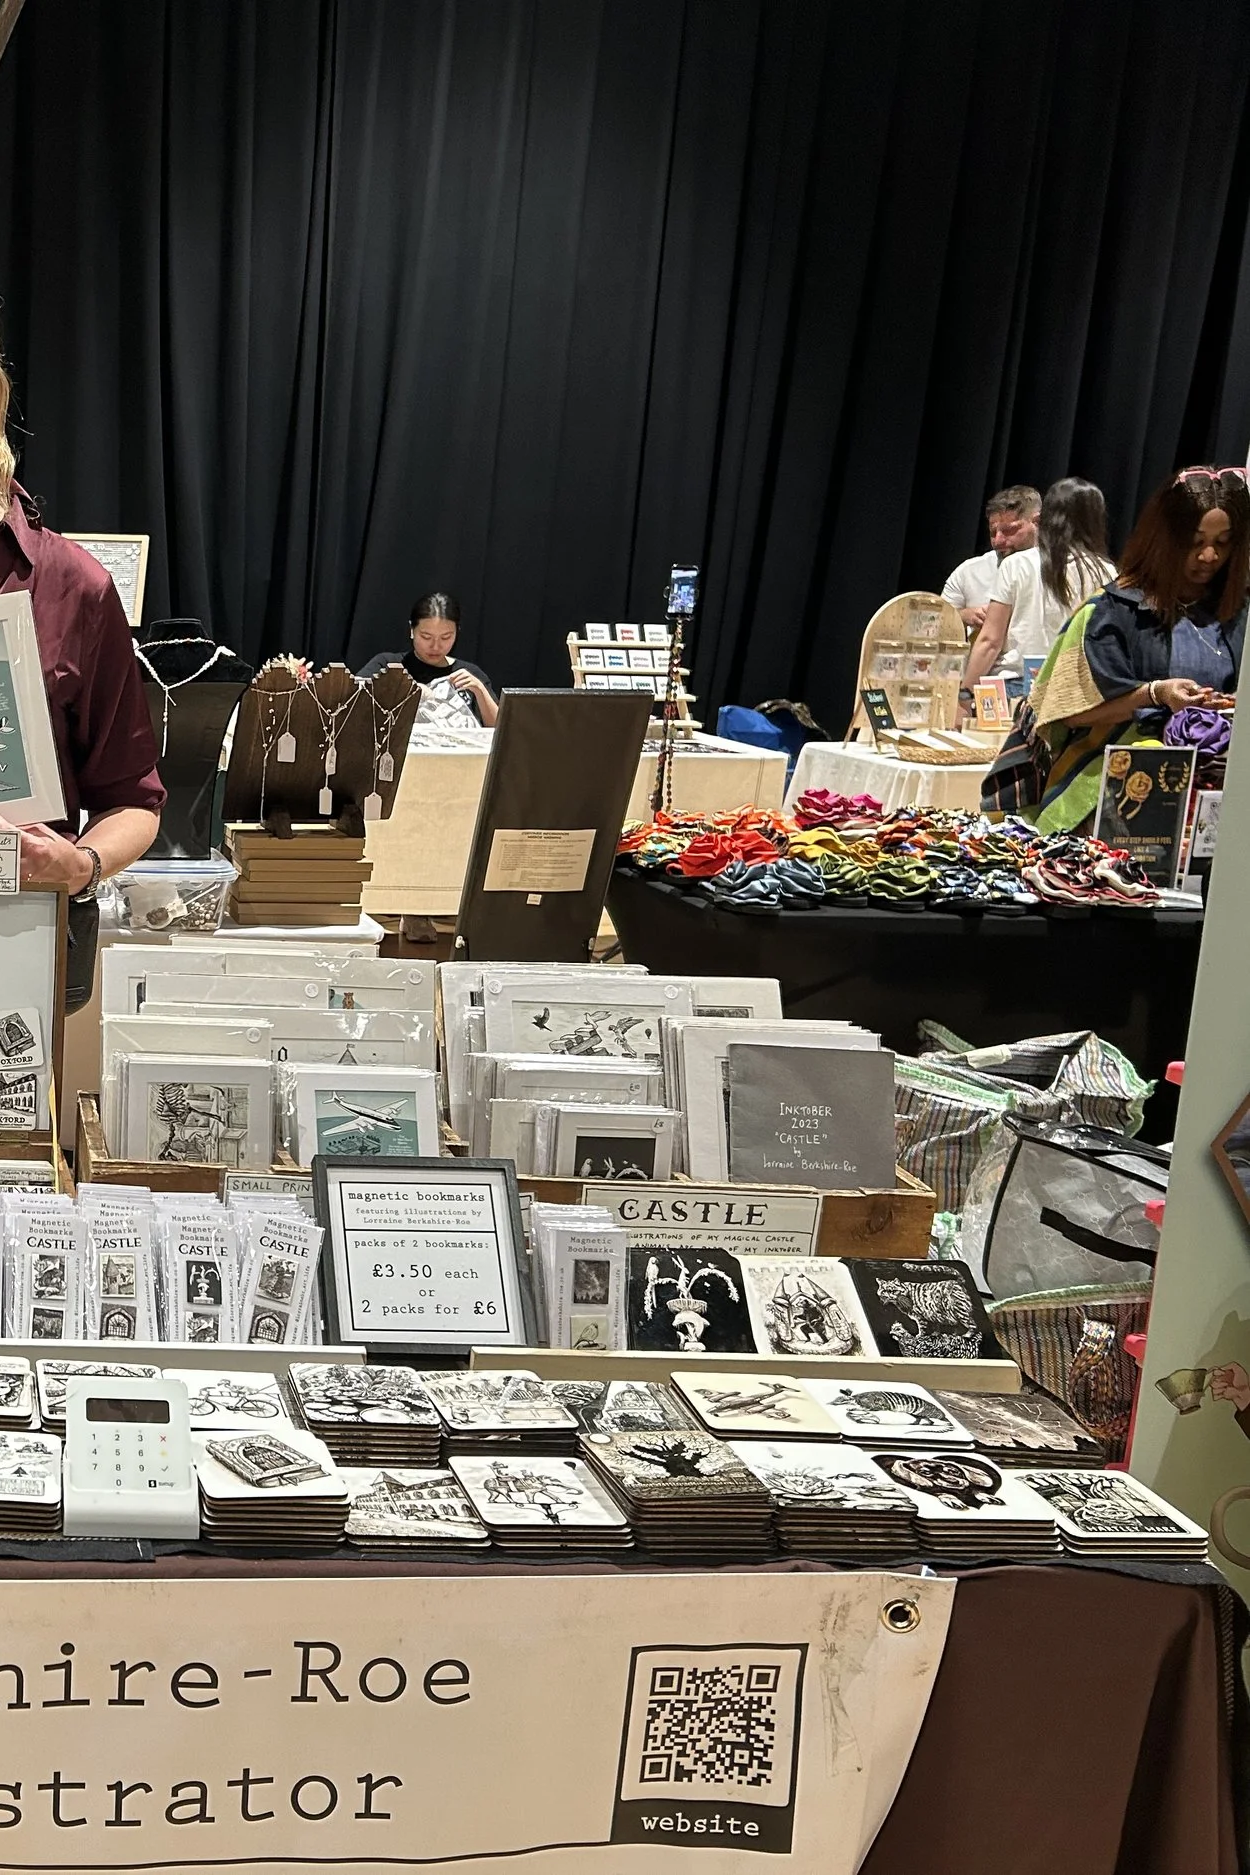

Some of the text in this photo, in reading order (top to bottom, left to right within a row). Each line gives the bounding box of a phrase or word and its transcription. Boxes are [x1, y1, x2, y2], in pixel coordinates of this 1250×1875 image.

[0, 1056, 34, 1066] OXFORD
[780, 1102, 832, 1117] INKTOBER
[792, 1118, 818, 1129] 2023
[794, 1146, 802, 1157] by
[764, 1153, 794, 1168] Lorraine
[232, 1181, 272, 1190] SMALL
[348, 1191, 486, 1202] magnetic bookmarks
[355, 1208, 482, 1217] featuring illustrations by
[618, 1198, 768, 1226] CASTLE
[31, 1218, 71, 1227] Magnetic
[267, 1219, 308, 1234] Magnetic
[28, 1226, 74, 1236] Bookmarks
[92, 1227, 138, 1235] Bookmarks
[264, 1226, 308, 1243] Bookmarks
[26, 1236, 77, 1250] CASTLE
[93, 1236, 142, 1249] CASTLE
[354, 1239, 386, 1248] packs
[412, 1240, 419, 1248] 2
[425, 1240, 490, 1249] bookmarks:
[570, 1236, 612, 1245] Magnetic
[259, 1236, 310, 1258] CASTLE
[568, 1246, 614, 1254] Bookmarks
[372, 1264, 479, 1279] £3.50 each
[418, 1289, 436, 1298] or
[362, 1300, 497, 1316] 2 packs for £6
[138, 1434, 144, 1442] 3
[92, 1448, 98, 1456] 4
[138, 1449, 144, 1457] 6
[92, 1462, 145, 1472] 7 8 9
[116, 1478, 122, 1486] 0
[641, 1812, 760, 1837] website
